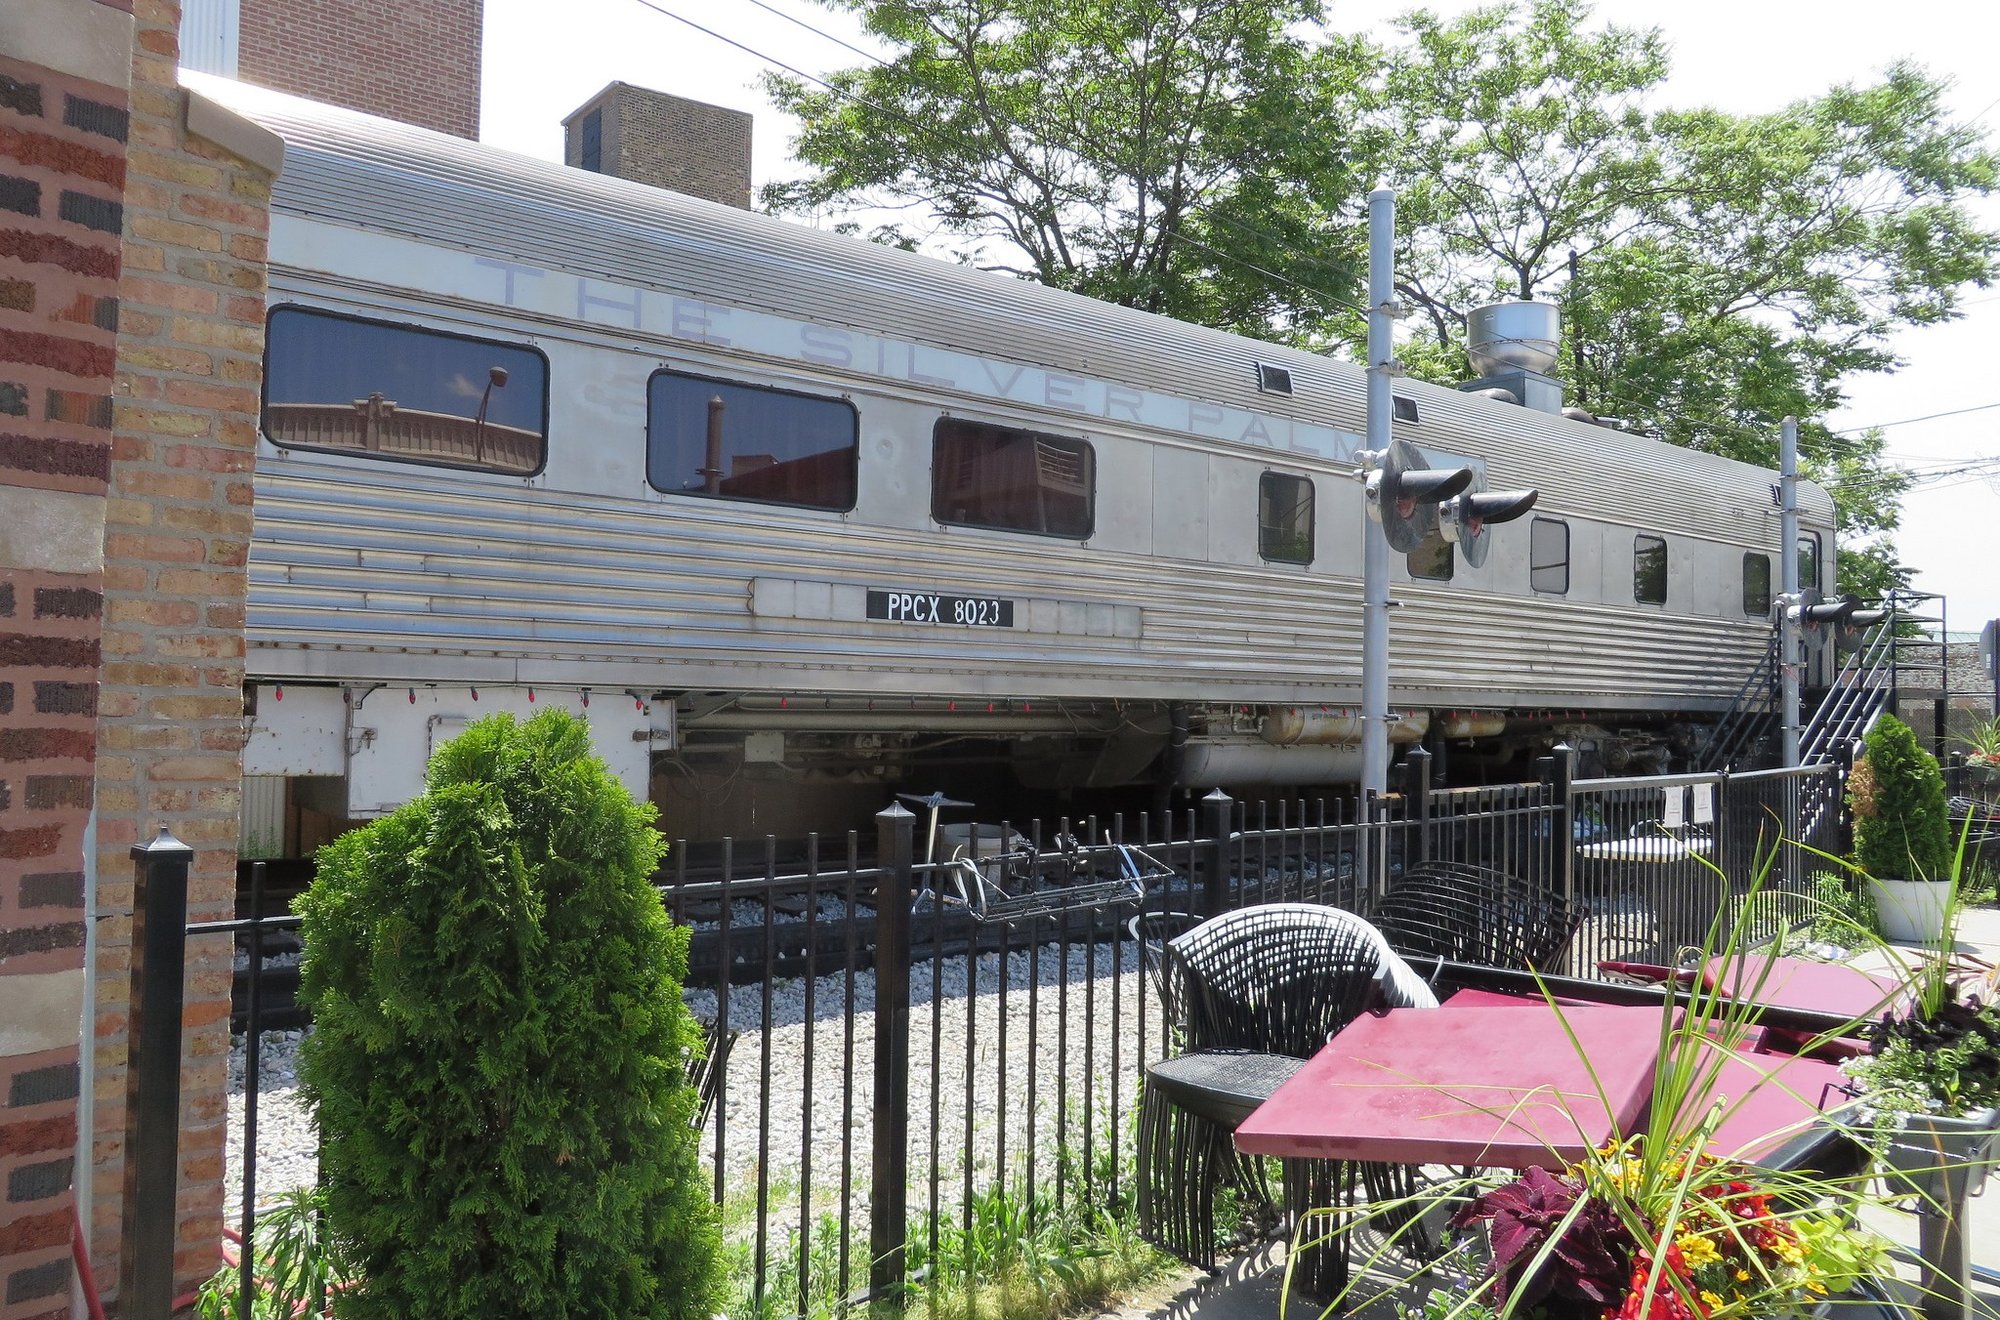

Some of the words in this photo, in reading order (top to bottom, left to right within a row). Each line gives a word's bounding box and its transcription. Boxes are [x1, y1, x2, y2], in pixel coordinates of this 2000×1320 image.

[475, 256, 731, 346] THE
[800, 323, 1145, 422] SILVER
[1187, 401, 1367, 463] PALM
[888, 593, 940, 623] PPCX
[954, 599, 1000, 625] 8023
